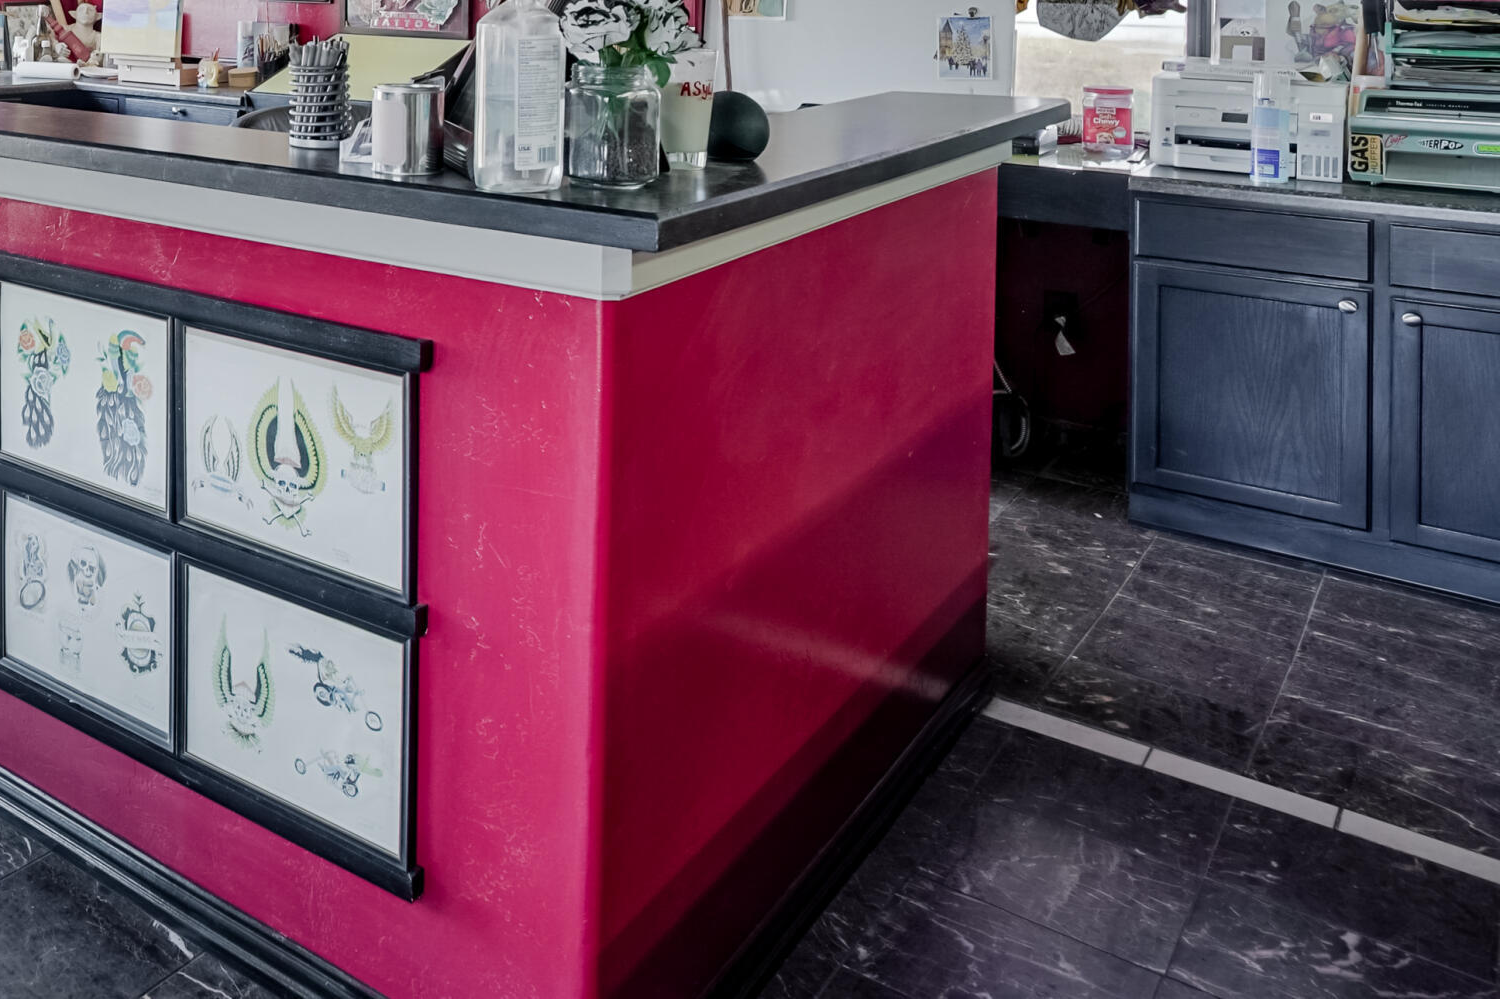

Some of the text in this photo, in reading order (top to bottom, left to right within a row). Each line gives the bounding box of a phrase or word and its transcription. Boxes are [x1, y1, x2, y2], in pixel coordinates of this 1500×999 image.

[1093, 117, 1120, 126] Chewy
[1351, 136, 1378, 174] GAS HUFFER
